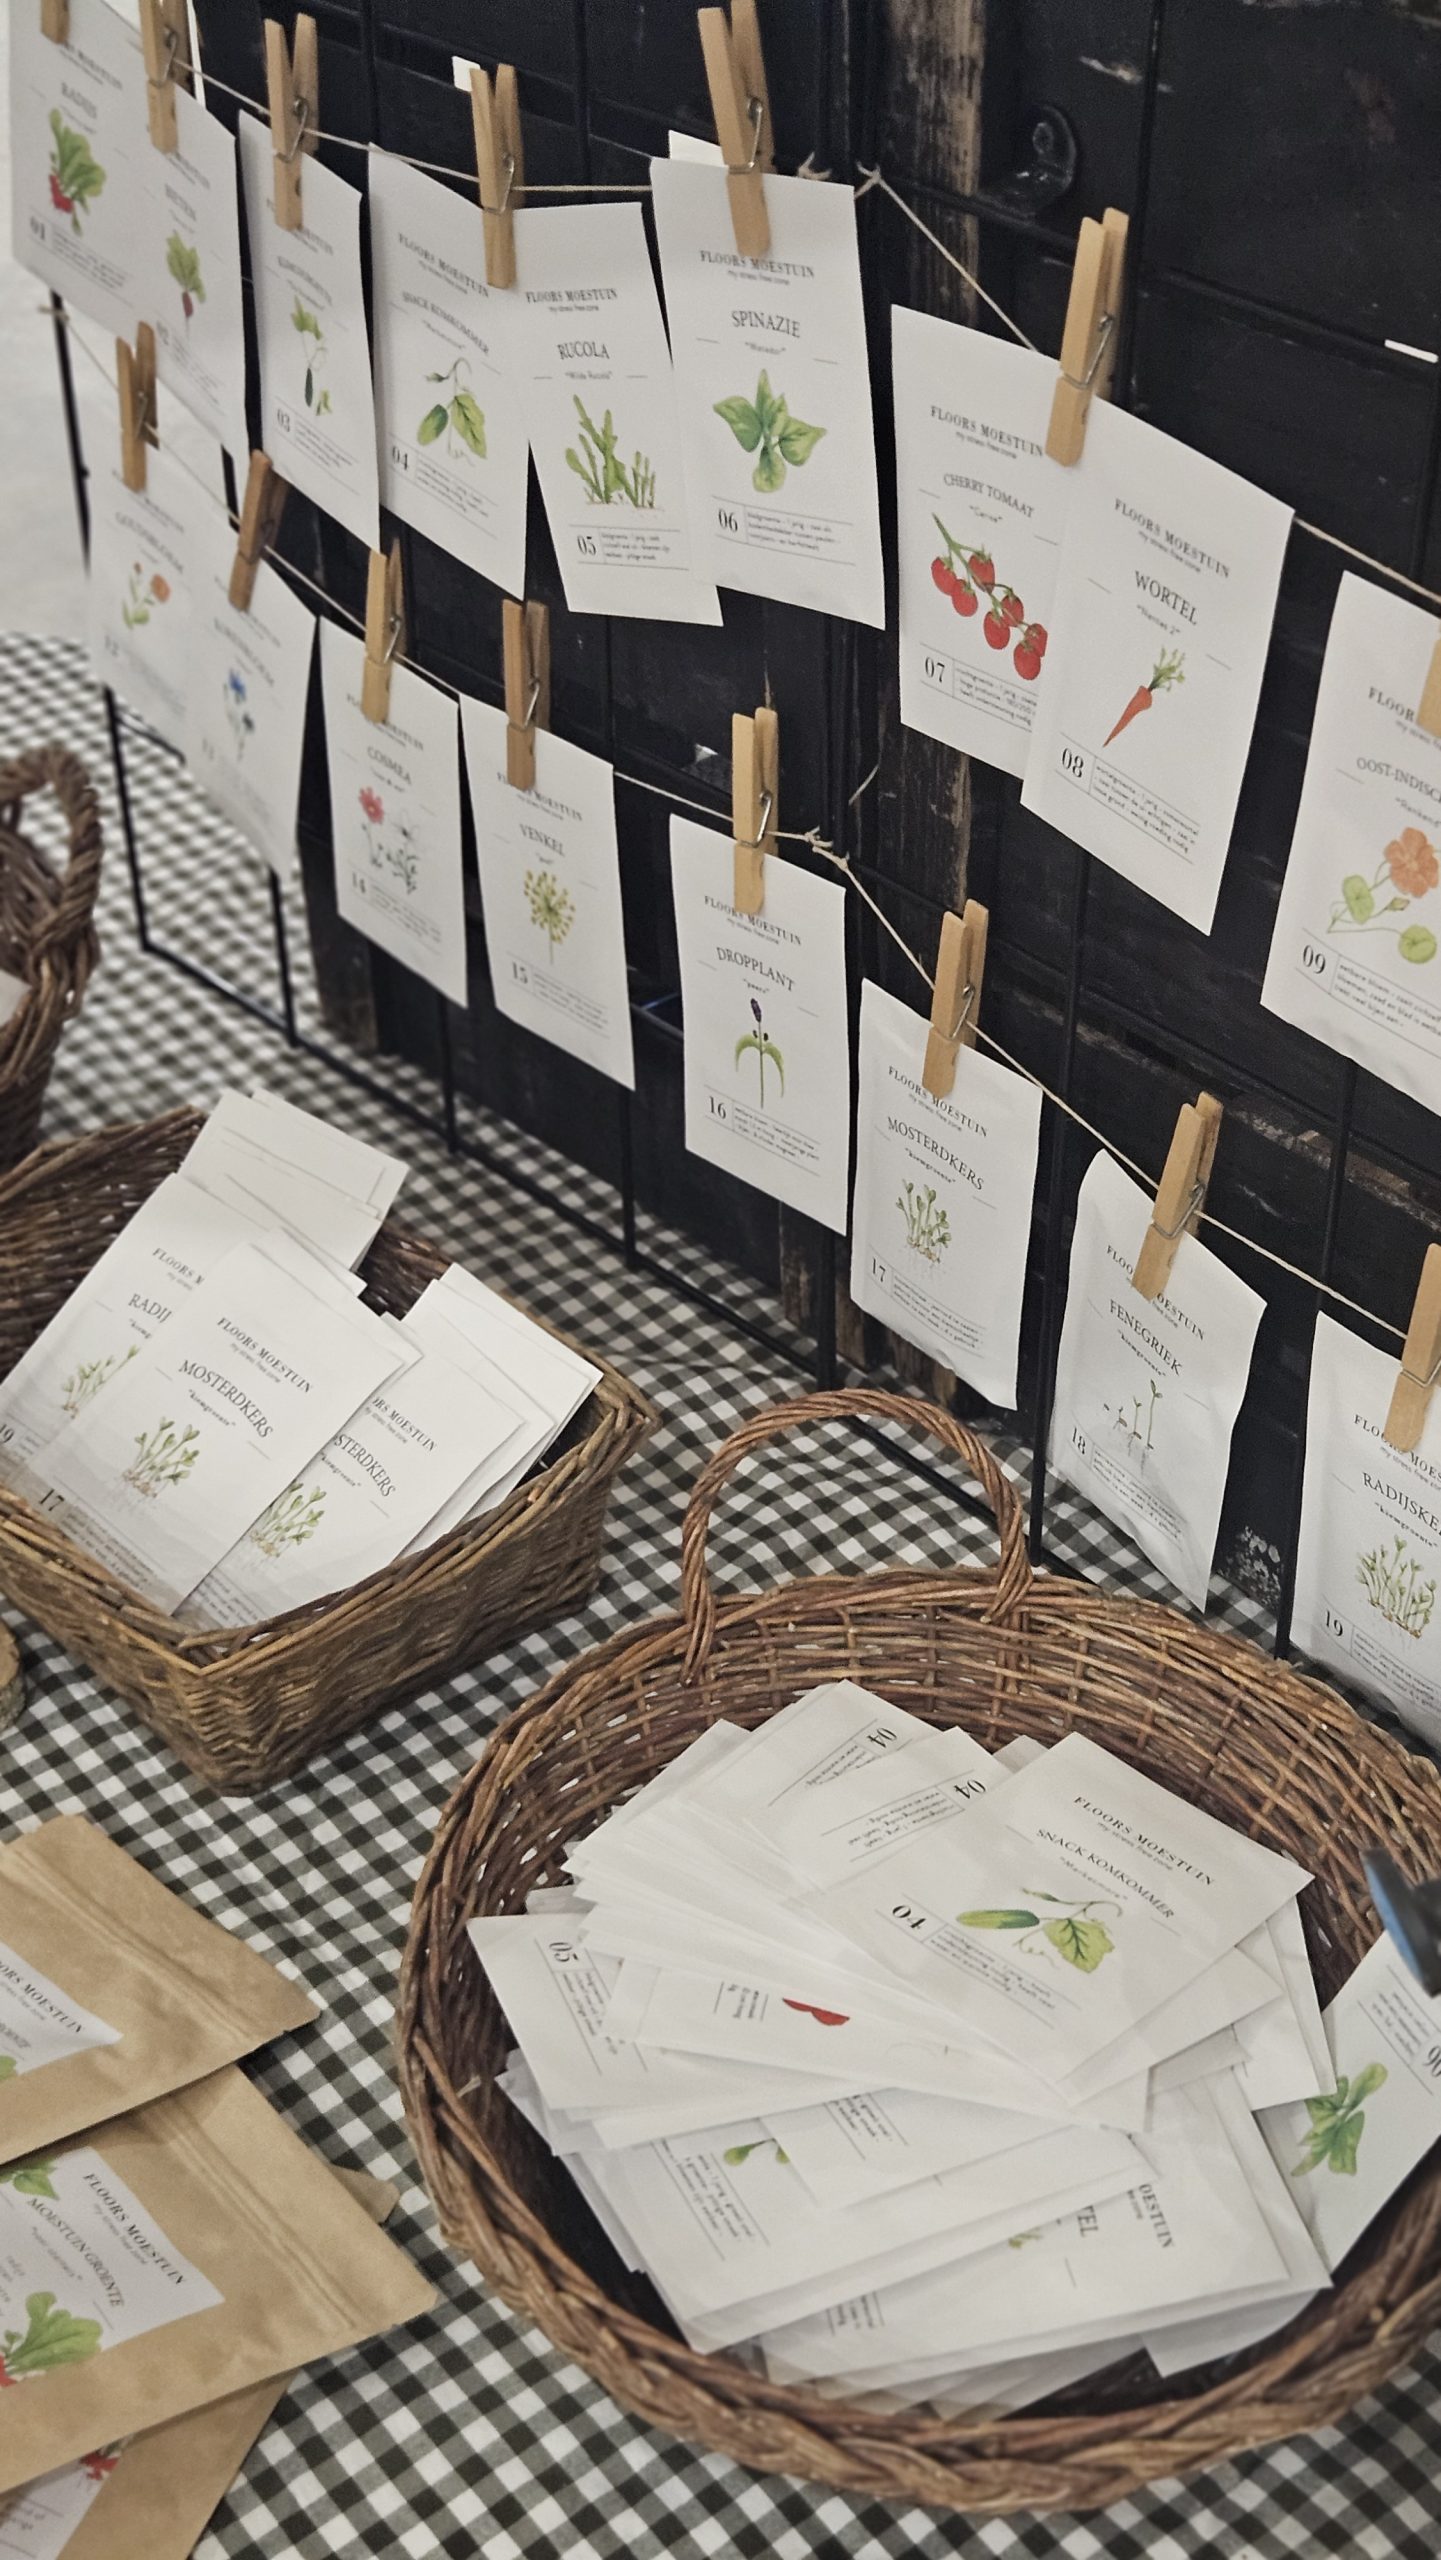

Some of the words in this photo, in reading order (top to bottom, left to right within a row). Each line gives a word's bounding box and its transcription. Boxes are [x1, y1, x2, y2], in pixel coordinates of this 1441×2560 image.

[700, 250, 747, 267] FLOORS
[750, 258, 815, 278] MOESTUIN
[526, 291, 564, 304] FLOORS
[565, 288, 618, 302] MOESTUIN
[731, 310, 801, 339] SPINAZIE
[557, 341, 610, 360] RUCOLA
[930, 405, 976, 432] FLOORS
[981, 423, 1043, 457] MOESTUIN
[392, 446, 408, 471] 04
[943, 473, 984, 494] CHERRY
[987, 485, 1034, 518] TOMAAT
[718, 509, 738, 532] 06
[577, 535, 596, 556] 05
[1114, 498, 1161, 537] FLOORS
[1165, 529, 1230, 578] MOESTUIN
[1134, 570, 1199, 626] WORTEL
[925, 656, 945, 683] 07
[1368, 687, 1415, 722] FLOOR
[366, 746, 412, 786] COSMEA
[1061, 747, 1084, 778] 08
[519, 823, 565, 857] VENKEL
[704, 895, 744, 919] FLOORS
[748, 914, 802, 946] MOESTUIN
[512, 961, 528, 984] 15
[716, 947, 796, 992] DROPPLANT
[1303, 944, 1326, 974] 09
[709, 1095, 726, 1119] 16
[887, 1065, 927, 1099] FLOORS
[932, 1093, 988, 1138] MOESTUIN
[887, 1115, 985, 1190] MOSTERDKERS
[152, 1247, 193, 1278] FLOORS
[872, 1258, 886, 1282] 17
[128, 1293, 173, 1323] RADIJ
[1106, 1245, 1134, 1275] FLOO
[1157, 1292, 1206, 1340] OESTUIN
[217, 1317, 259, 1351] FLOORS
[258, 1347, 313, 1393] MOESTUIN
[1110, 1299, 1182, 1377] FENEGRIEK
[178, 1360, 274, 1438] MOSTERDKERS
[390, 1408, 438, 1452] MOESTUIN
[1072, 1427, 1086, 1455] 18
[332, 1433, 397, 1498] STERDKERS
[39, 1488, 65, 1512] 17
[1363, 1472, 1441, 1536] RADIJSKE
[1325, 1610, 1343, 1636] 19
[866, 1727, 897, 1749] 04
[953, 1779, 986, 1800] 04
[1074, 1796, 1132, 1834] FLOORS
[1135, 1834, 1214, 1886] MOESTUIN
[1036, 1828, 1088, 1857] SNACK
[1087, 1853, 1175, 1919] KOMKOMMER
[892, 1905, 927, 1930] 04
[549, 1942, 579, 1962] 05
[24, 1983, 83, 2034] MOESTUIN
[83, 2172, 129, 2223] FLOORS
[126, 2223, 187, 2286] MOESTUIN
[1077, 2204, 1098, 2238] TEL
[1138, 2183, 1176, 2249] OESTUIN
[27, 2196, 87, 2254] MOESTUIN
[84, 2251, 125, 2308] GROENTE
